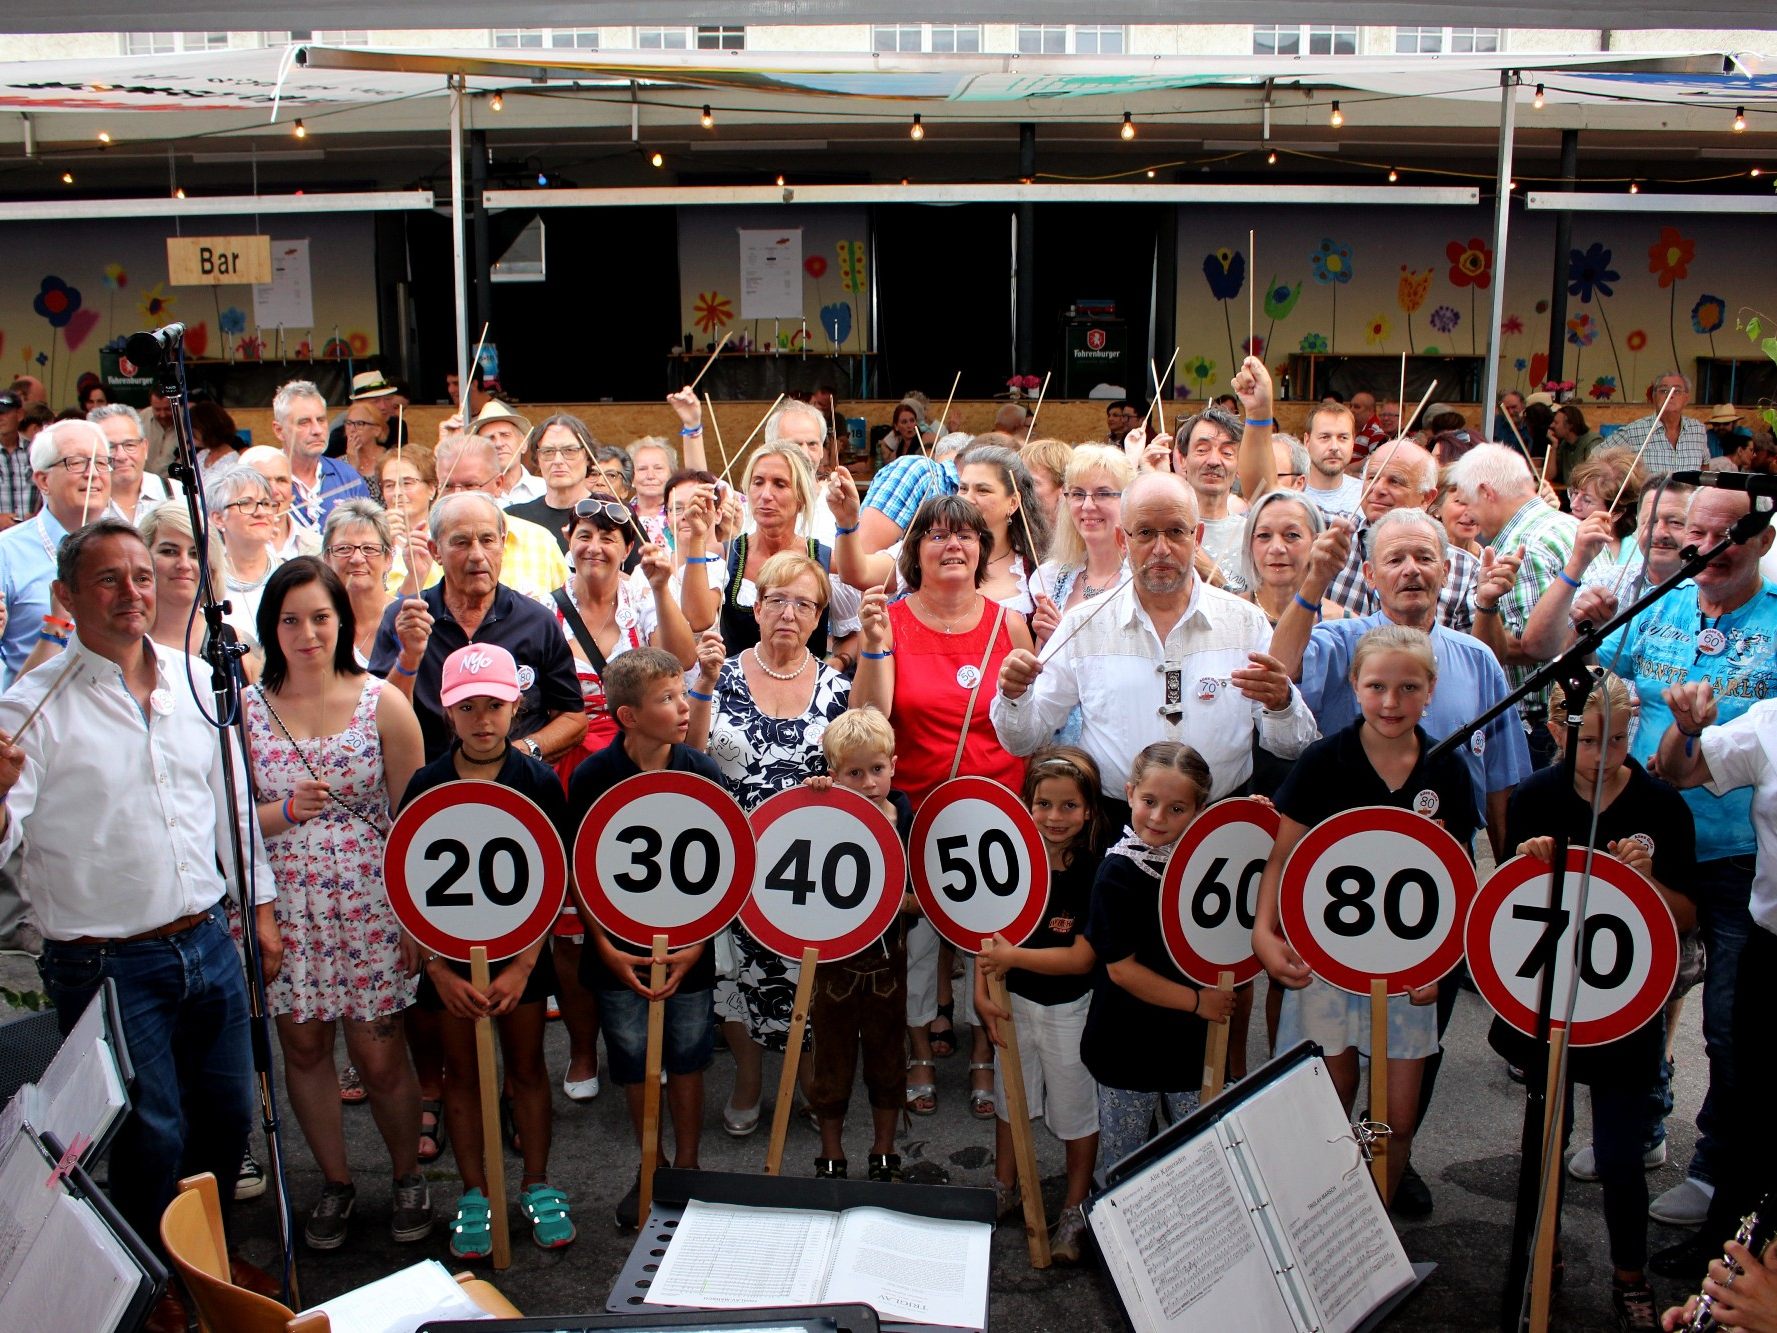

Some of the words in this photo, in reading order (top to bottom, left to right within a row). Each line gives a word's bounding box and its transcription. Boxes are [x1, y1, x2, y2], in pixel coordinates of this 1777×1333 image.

[200, 247, 240, 275] Bar
[1074, 349, 1120, 359] Fohrenburger
[1703, 634, 1720, 647] 60
[960, 669, 975, 682] 50
[1202, 681, 1217, 694] 70
[346, 735, 362, 749] 20
[1420, 796, 1435, 809] 80
[424, 836, 530, 907] 20
[612, 824, 721, 896] 30
[764, 838, 872, 910] 40
[936, 827, 1020, 903] 50
[1191, 857, 1263, 930] 60
[1323, 865, 1440, 941] 80
[1511, 903, 1636, 990] 70
[878, 1294, 928, 1310] TRIGLAV
